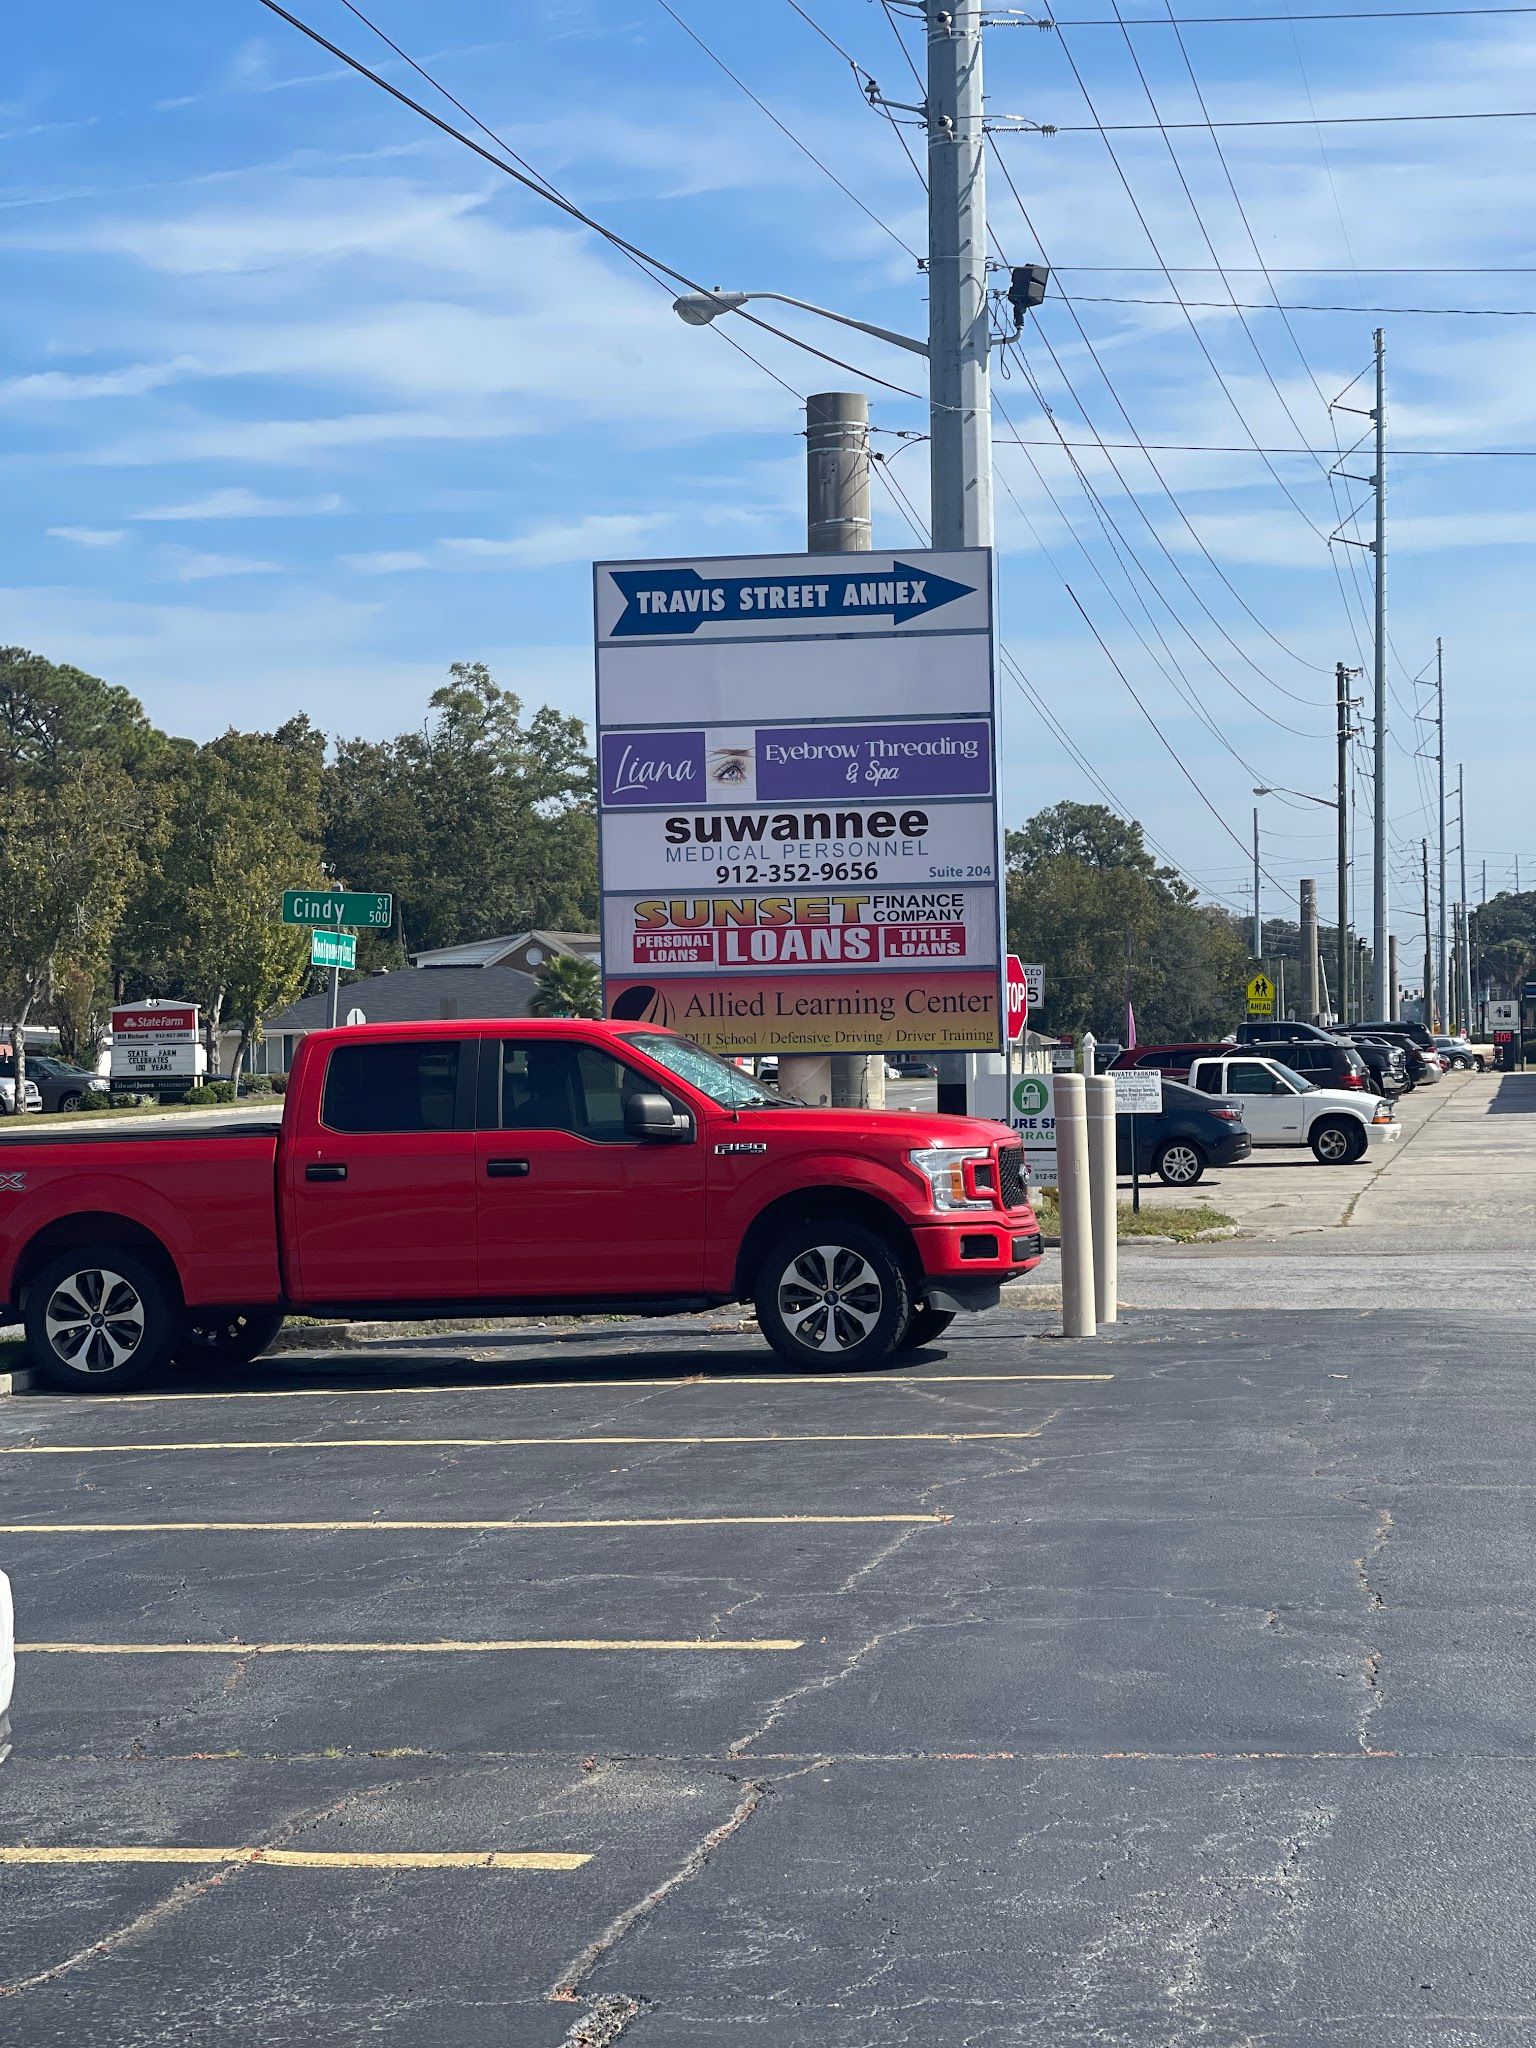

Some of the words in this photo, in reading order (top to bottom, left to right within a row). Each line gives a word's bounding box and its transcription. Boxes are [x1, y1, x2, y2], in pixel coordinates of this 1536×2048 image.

[636, 588, 725, 614] TRAVIS
[739, 584, 829, 611] STREET
[842, 580, 927, 606] ANNEX
[765, 744, 860, 765] Eyebrow
[864, 737, 979, 759] Threading
[612, 744, 697, 794] Liana
[845, 763, 858, 783] &
[864, 760, 900, 788] Spa
[664, 809, 929, 844] suwannee
[666, 845, 770, 863] MEDICAL
[783, 840, 929, 859] PERSONNEL
[716, 861, 878, 884] 912-352-9656
[928, 866, 963, 878] Suite
[966, 865, 992, 878] 204
[293, 896, 345, 925] Cindy
[376, 898, 389, 910] ST
[873, 894, 964, 908] FINANCE
[368, 910, 388, 923] 500
[633, 895, 871, 929] SUNSET
[873, 908, 964, 923] COMPANY
[636, 934, 711, 948] PERSONAL
[727, 928, 870, 962] LOANS
[898, 929, 951, 943] TITLE
[649, 948, 699, 963] LOANS
[889, 941, 961, 957] LOANS
[684, 991, 765, 1018] Allied
[776, 990, 895, 1021] Learning
[904, 989, 993, 1014] Center
[1006, 982, 1025, 1013] TOP
[1027, 987, 1039, 1003] 5
[1250, 1002, 1271, 1011] AHEAD
[685, 1033, 711, 1046] DUI
[715, 1032, 757, 1045] School
[770, 1031, 831, 1045] Defensive
[835, 1030, 883, 1046] Driving
[896, 1029, 937, 1042] Driver
[941, 1028, 994, 1044] Training
